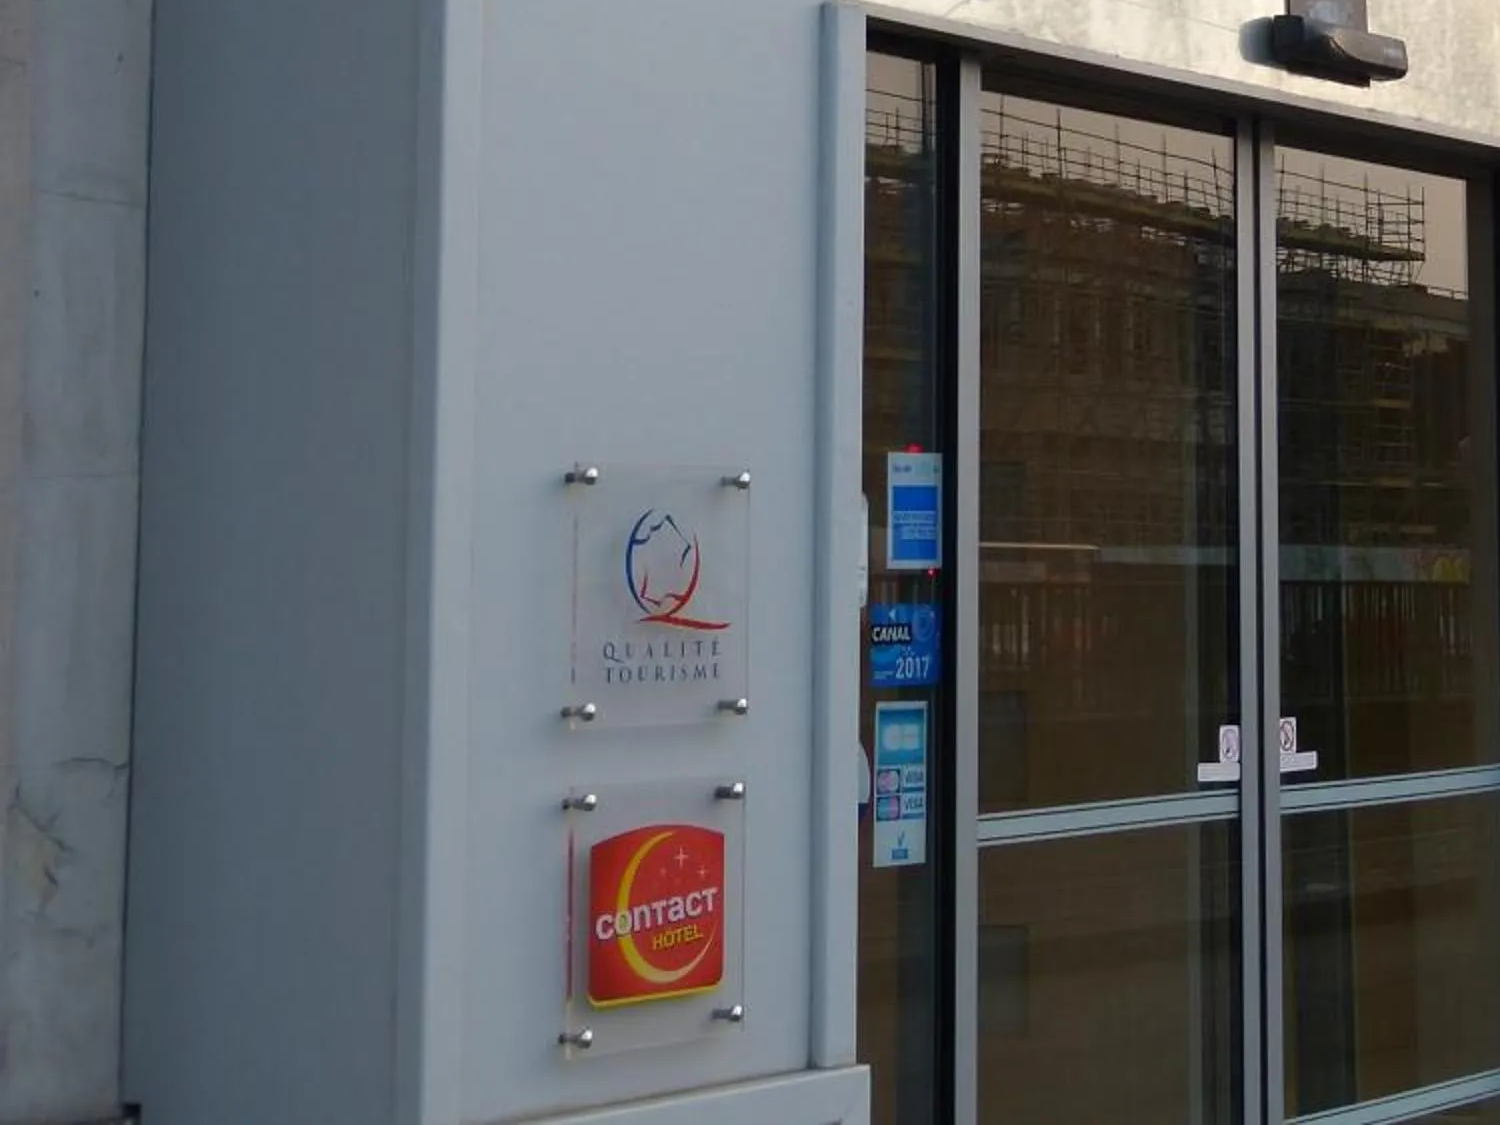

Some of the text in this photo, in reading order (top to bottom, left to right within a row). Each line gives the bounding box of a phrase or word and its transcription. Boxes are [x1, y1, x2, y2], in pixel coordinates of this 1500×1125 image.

[872, 626, 911, 642] CANAL
[604, 662, 721, 684] TOURISME
[895, 656, 929, 679] 2017
